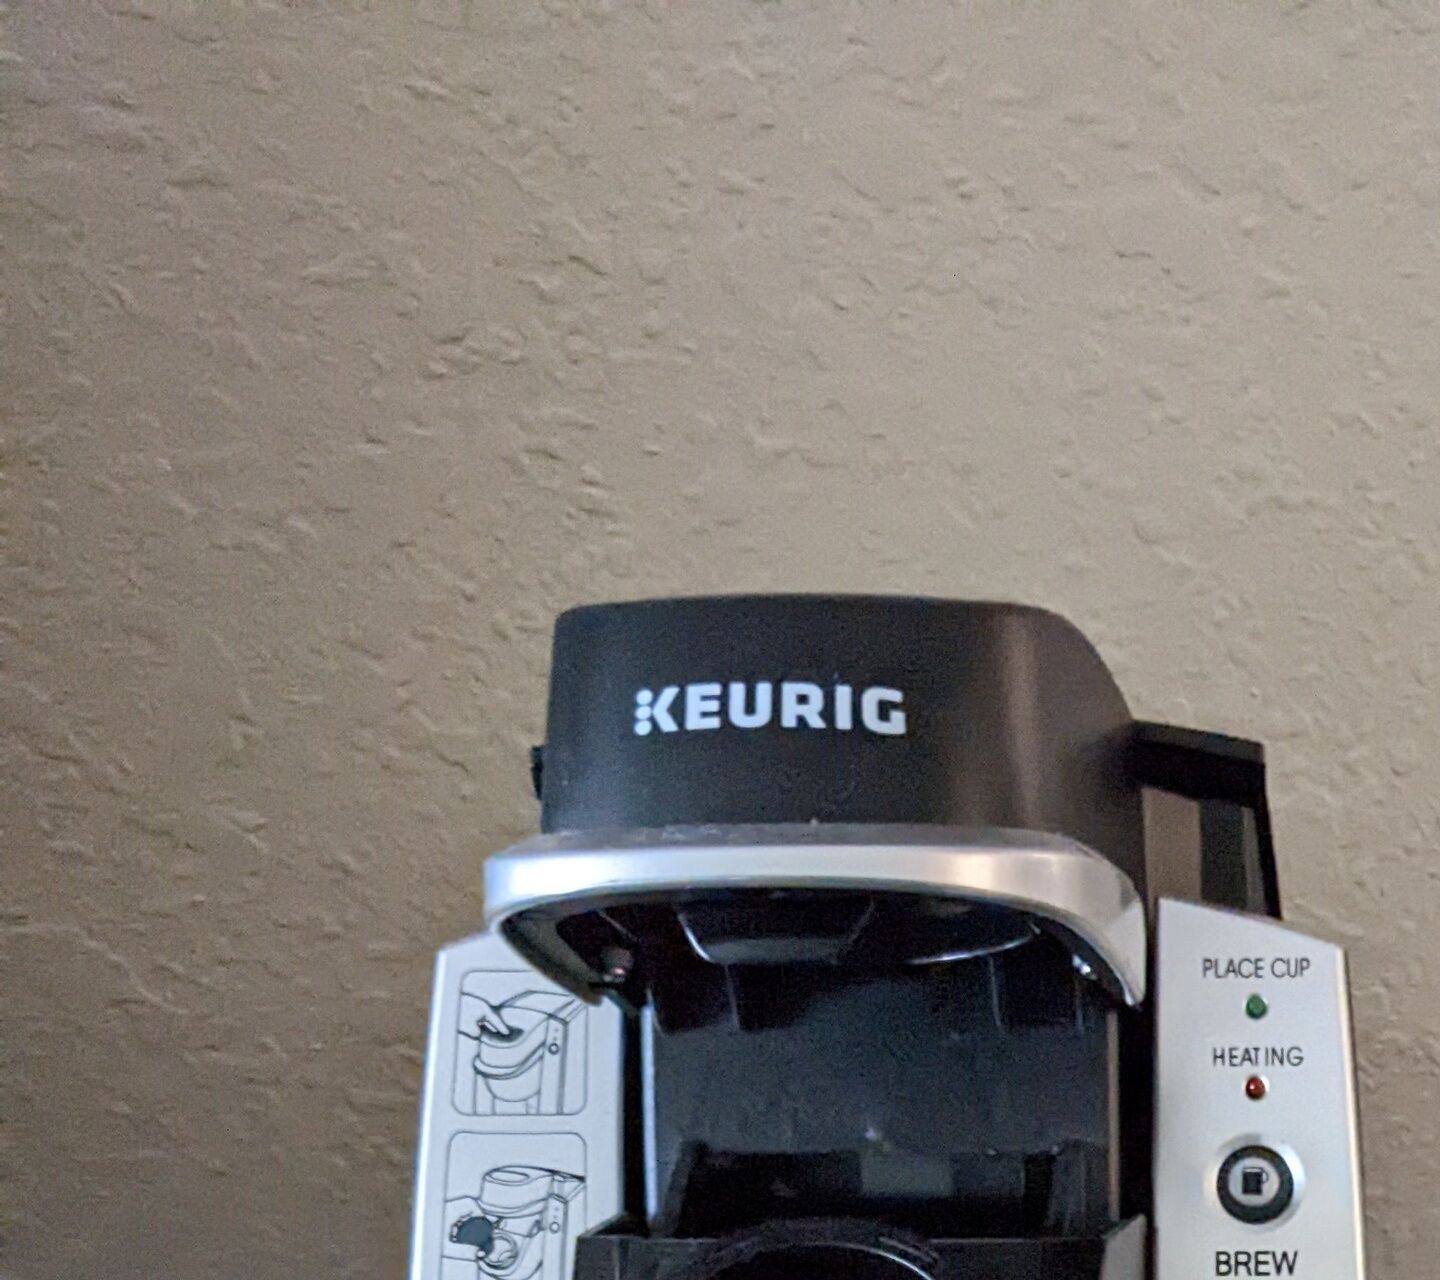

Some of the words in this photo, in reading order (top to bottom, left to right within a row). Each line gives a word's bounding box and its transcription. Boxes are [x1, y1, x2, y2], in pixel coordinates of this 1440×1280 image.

[634, 681, 907, 736] KEURIG
[1202, 957, 1264, 979] PLACE
[1271, 957, 1311, 978] CUP
[1212, 1047, 1304, 1067] HEATING
[1214, 1250, 1298, 1277] BREW
